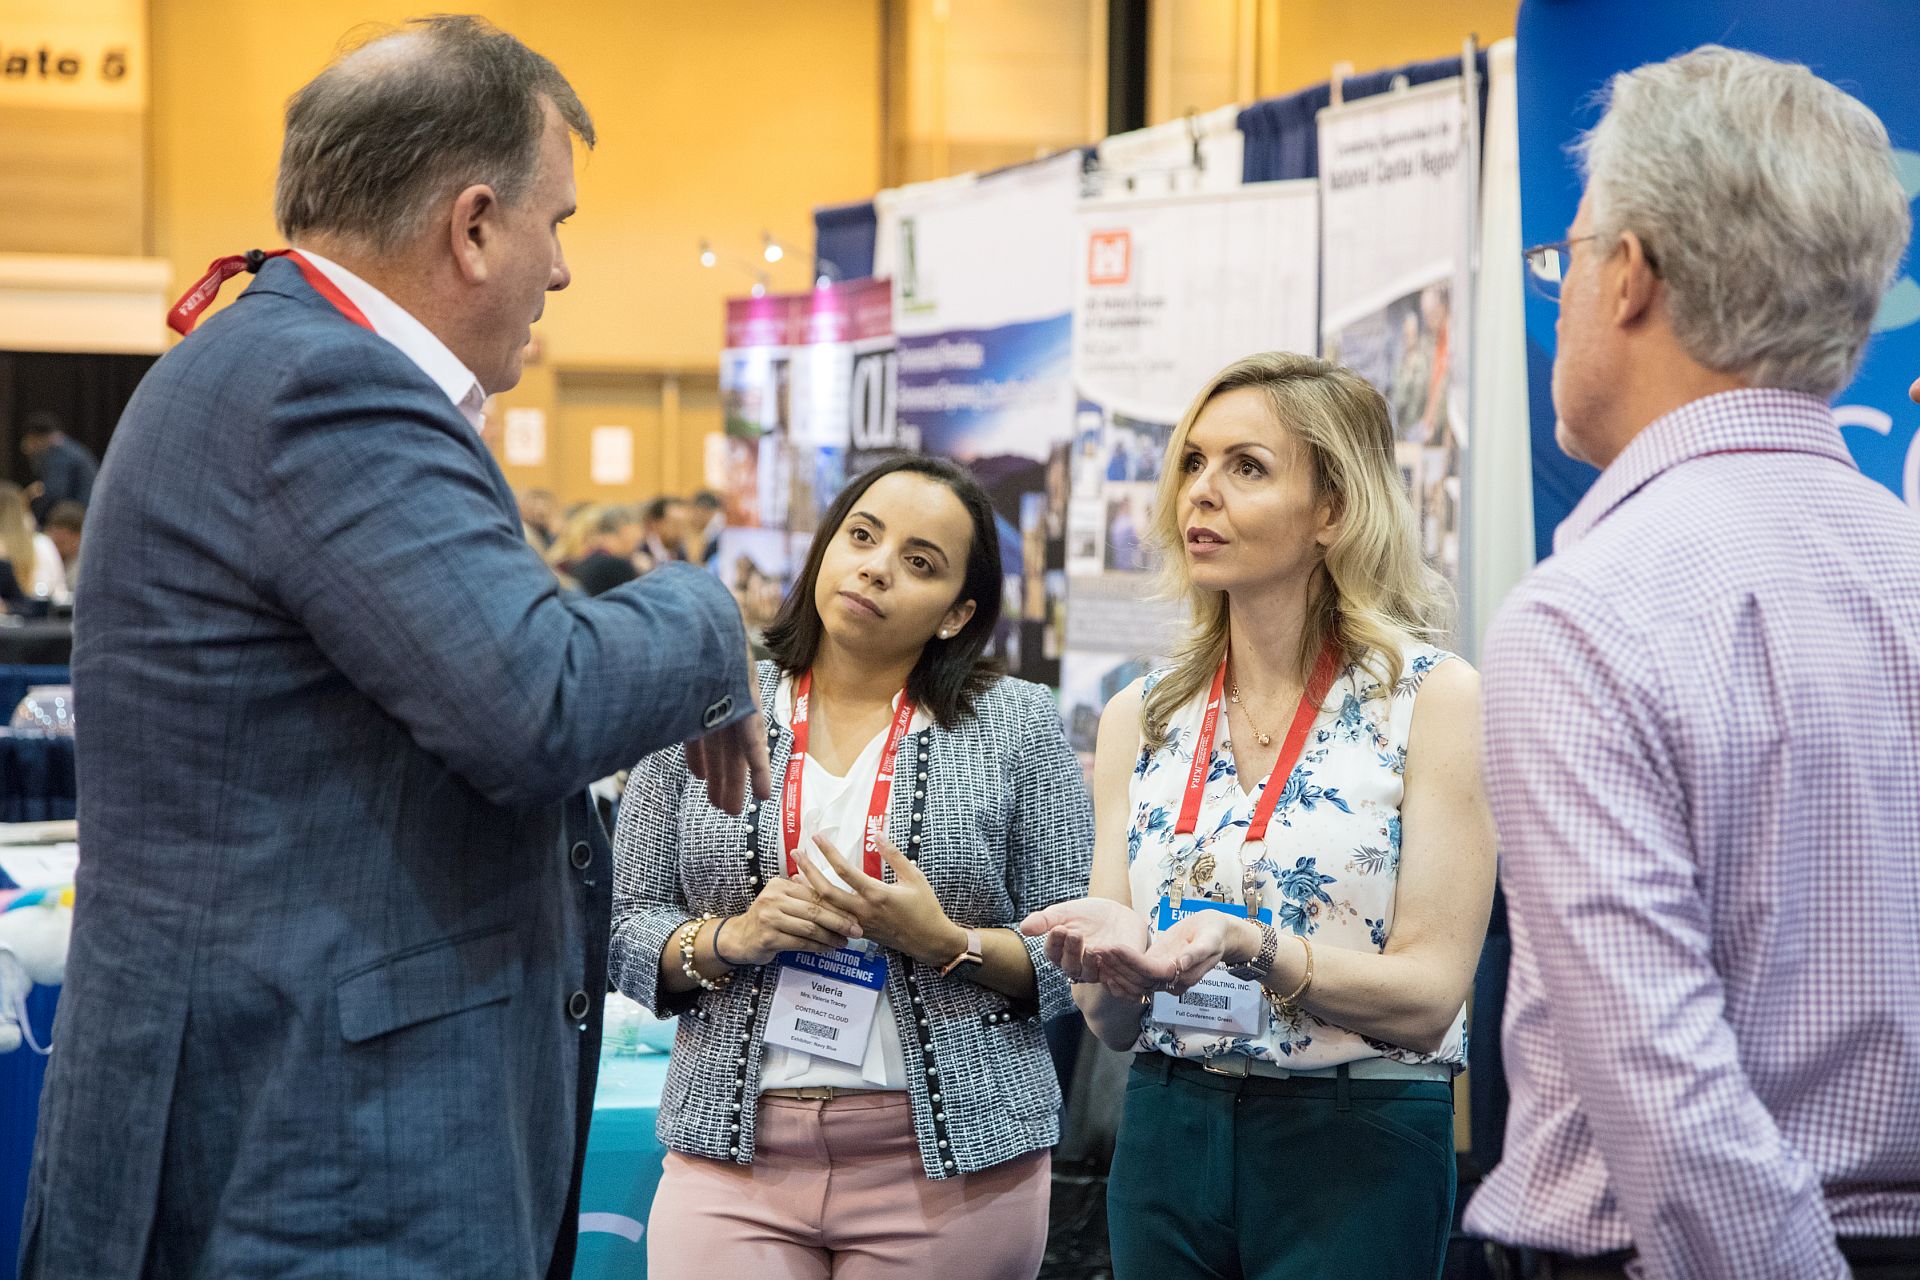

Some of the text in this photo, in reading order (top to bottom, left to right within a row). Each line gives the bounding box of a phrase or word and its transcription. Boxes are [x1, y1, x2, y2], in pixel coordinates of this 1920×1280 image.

[0, 46, 79, 79] ate
[795, 952, 874, 982] FULL CONFERENCE
[811, 981, 843, 997] Valeria
[1198, 979, 1236, 990] ONSULTING,
[800, 991, 811, 999] Mrs.
[812, 995, 830, 1004] Valeria
[794, 1004, 849, 1024] CONTRACT CLOUD
[1186, 1012, 1216, 1021] Conference:
